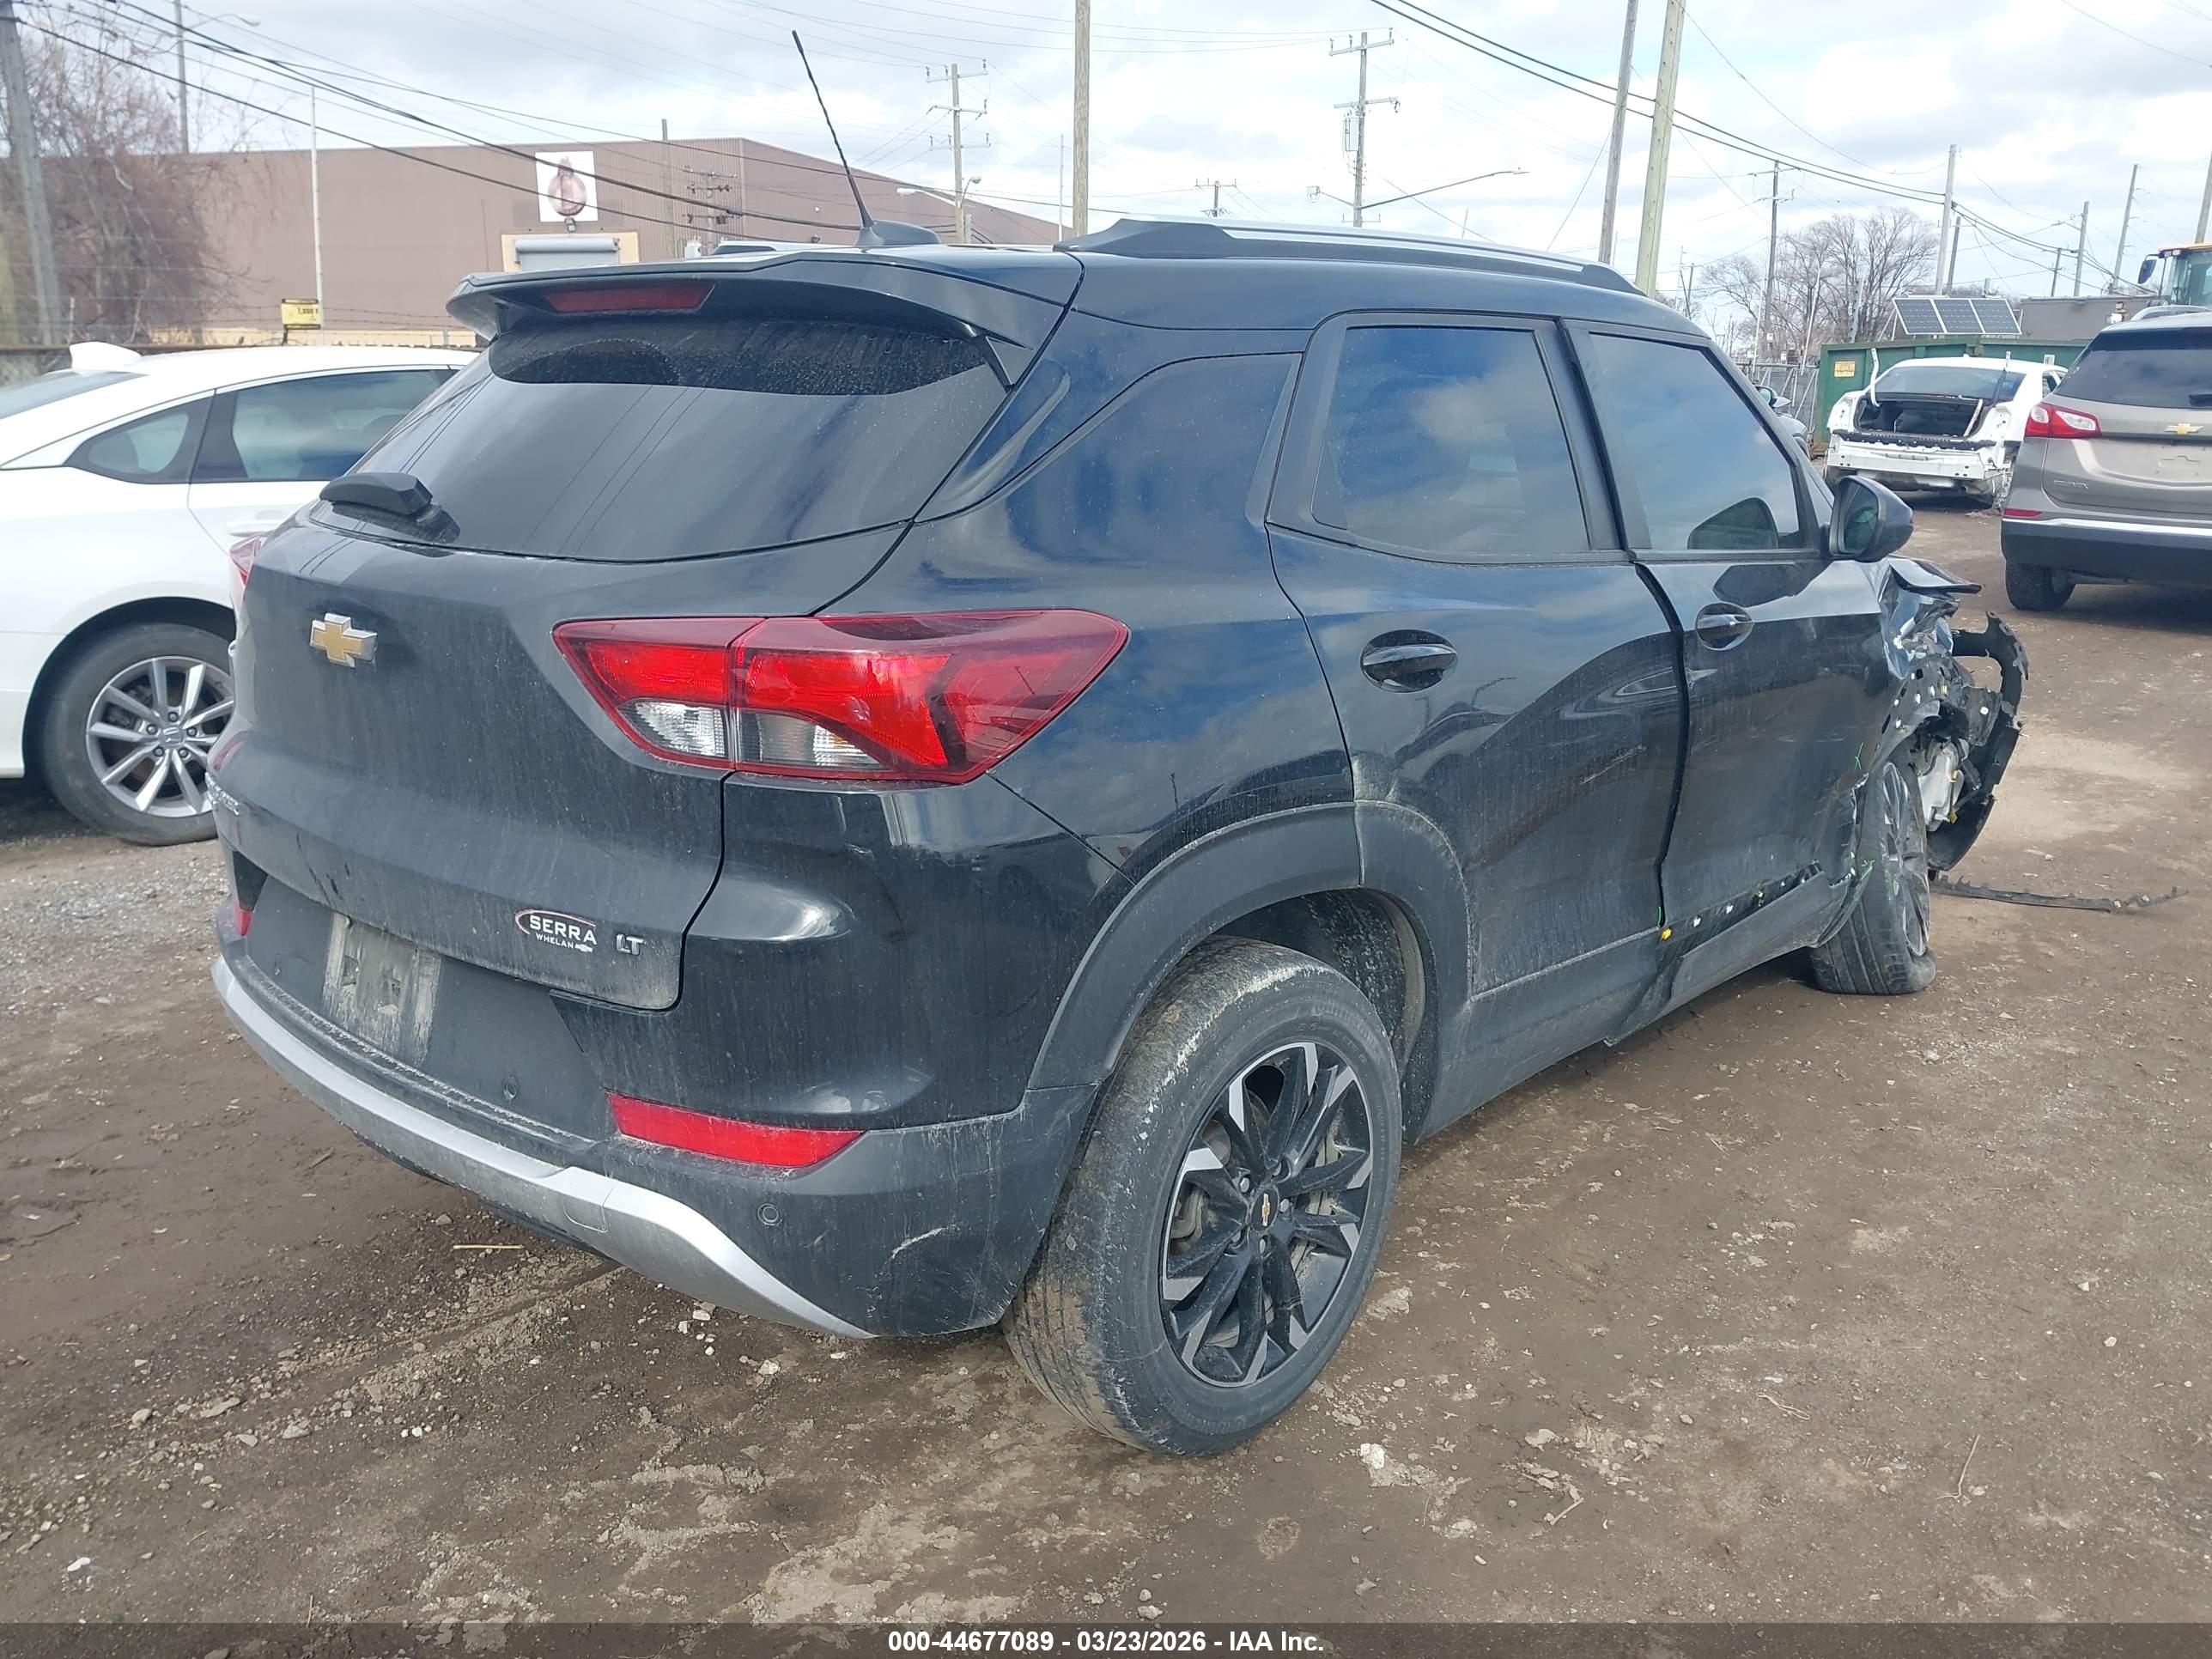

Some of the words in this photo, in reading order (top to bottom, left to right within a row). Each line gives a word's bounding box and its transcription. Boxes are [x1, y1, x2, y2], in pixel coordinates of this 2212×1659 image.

[530, 915, 598, 945] SERRA
[536, 933, 574, 949] WHELAN
[616, 933, 646, 956] LT
